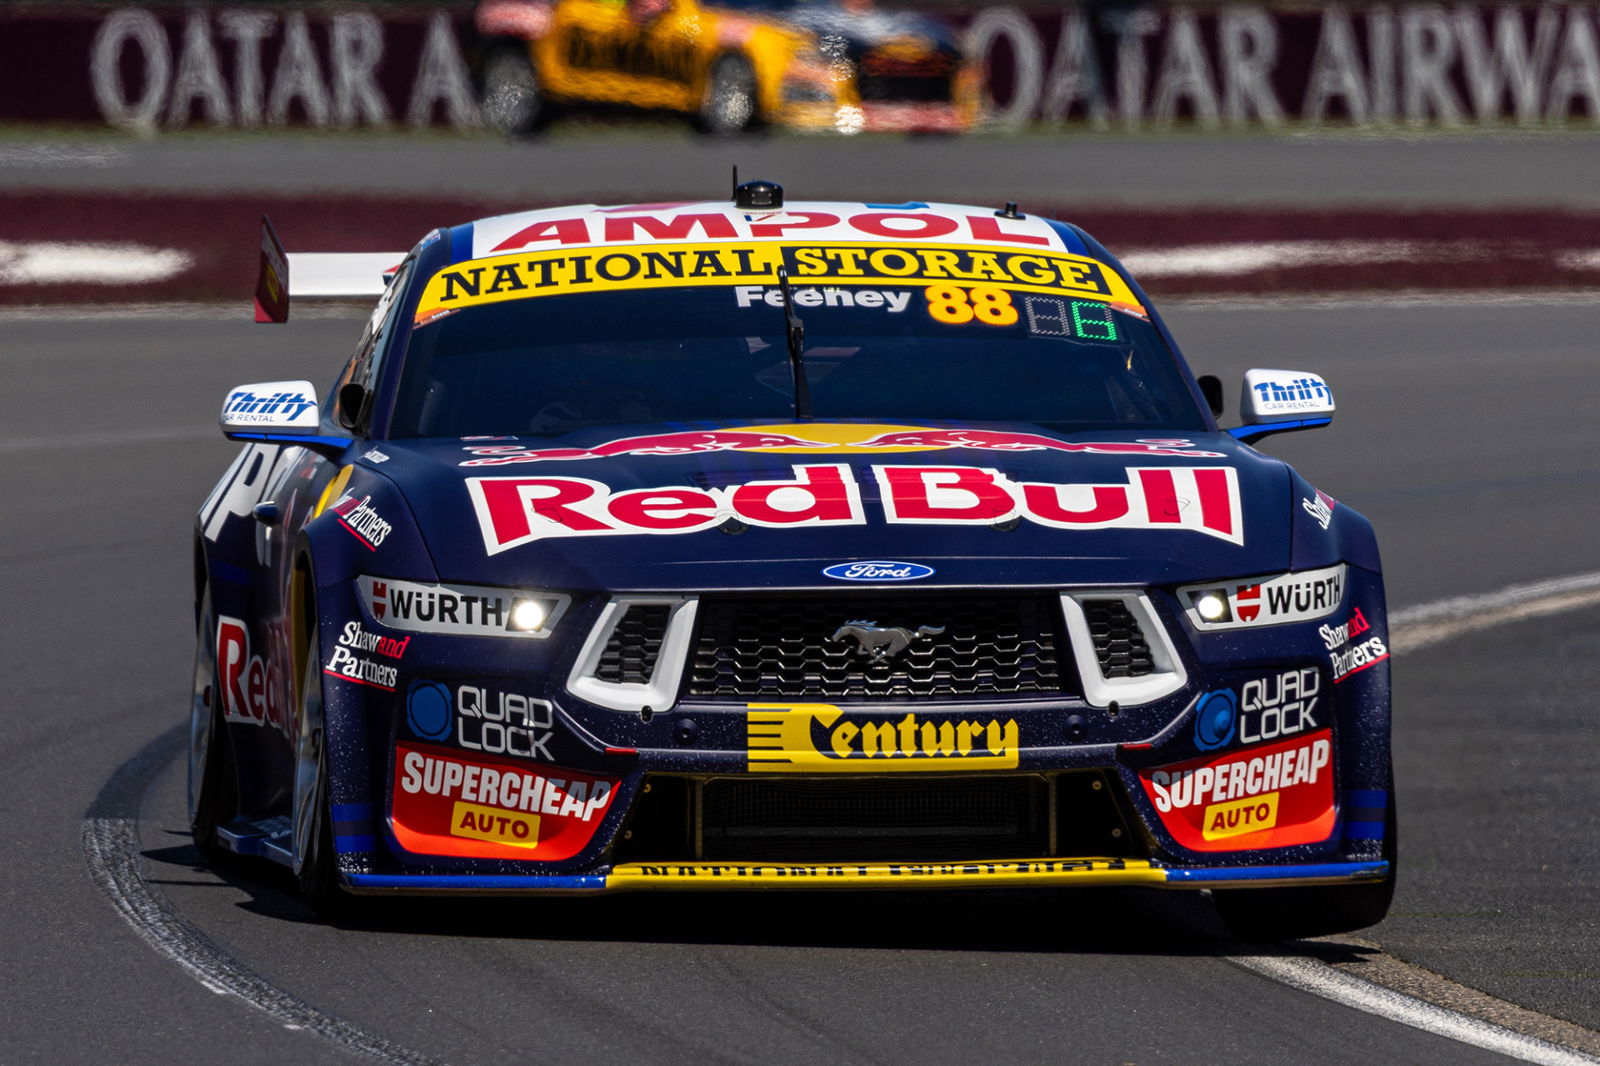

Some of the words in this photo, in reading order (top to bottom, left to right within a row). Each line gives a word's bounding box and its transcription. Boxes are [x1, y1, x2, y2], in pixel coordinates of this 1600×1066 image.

[91, 8, 390, 131] QATAR
[489, 212, 1050, 252] AMPOL
[440, 249, 773, 302] NATIONAL
[795, 249, 1099, 291] STORAGE
[735, 286, 912, 313] Feeney
[925, 285, 1019, 326] 88
[224, 392, 318, 422] Thrifty
[1254, 378, 1333, 406] Thrifty
[480, 466, 854, 546] Red
[884, 468, 1233, 536] Bull
[845, 563, 912, 578] Ford
[390, 588, 503, 627] WÜRTH
[1267, 573, 1341, 616] WÜRTH
[325, 645, 398, 688] Partners
[457, 685, 554, 729] QUAD
[1241, 667, 1320, 712] QUAD
[457, 716, 555, 762] LOCK
[766, 702, 1020, 772] Century
[1240, 697, 1318, 744] LOCK
[401, 751, 612, 823] SUPERCHEAP
[1151, 738, 1330, 813] SUPERCHEAP
[459, 811, 530, 839] AUTO
[1210, 802, 1270, 832] AUTO
